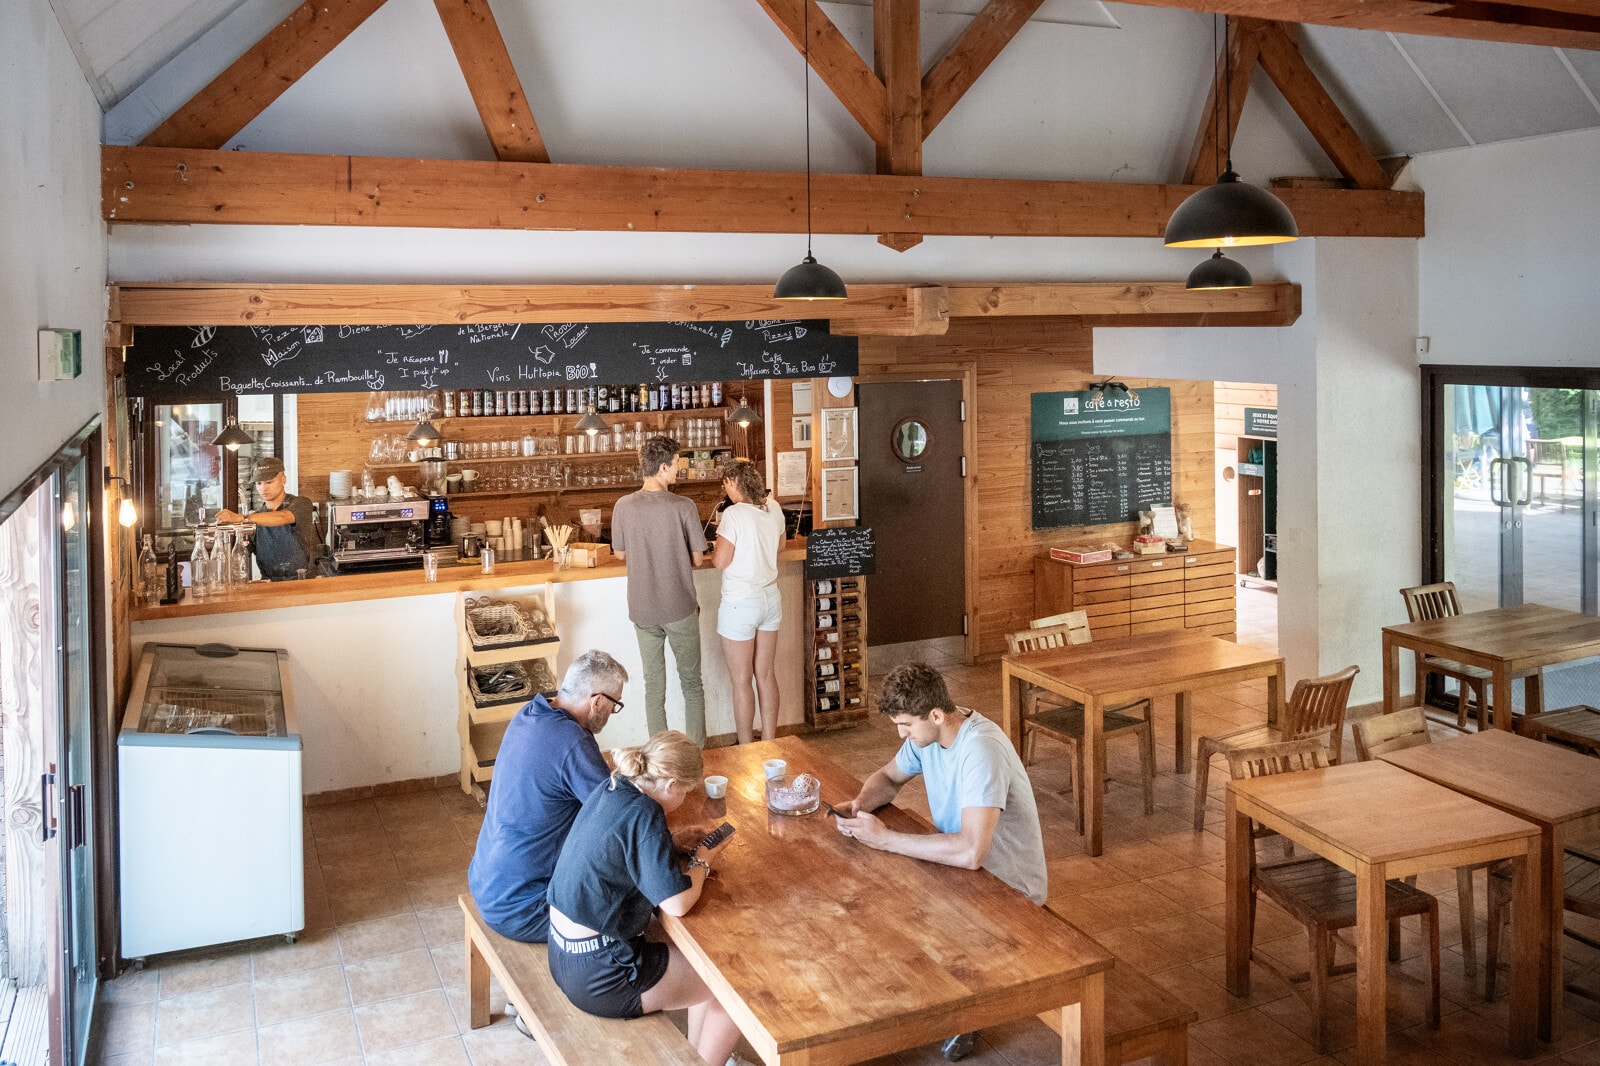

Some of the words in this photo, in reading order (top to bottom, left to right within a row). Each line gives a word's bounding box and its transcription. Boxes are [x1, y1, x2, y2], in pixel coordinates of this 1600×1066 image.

[262, 327, 299, 346] Pizza
[457, 327, 466, 336] de
[467, 325, 475, 334] la
[470, 329, 510, 344] Nationale
[761, 329, 793, 341] Pizzas
[261, 340, 301, 367] Maison
[655, 345, 690, 354] commande
[146, 349, 187, 382] Local
[175, 348, 219, 387] Products
[649, 356, 657, 365] I
[398, 367, 410, 378] I
[413, 367, 429, 378] pick
[431, 366, 439, 374] it
[486, 366, 511, 383] Vins
[518, 365, 562, 381] Huttopia
[773, 363, 782, 375] &
[314, 378, 324, 386] de
[324, 369, 380, 384] Rambouillet
[565, 938, 600, 954] PUMA
